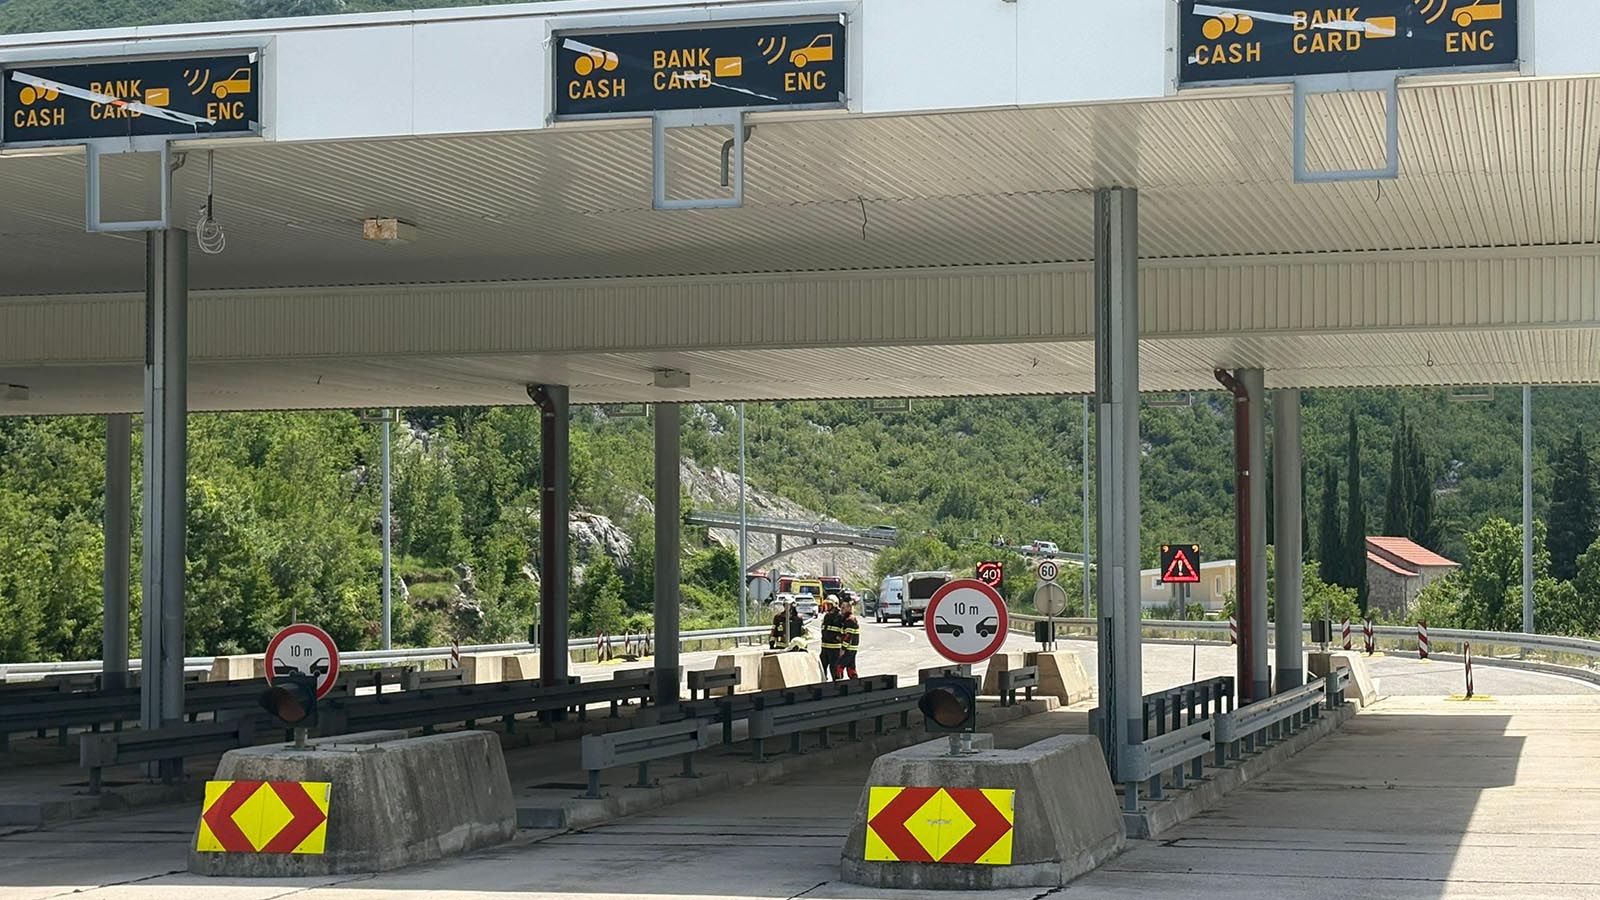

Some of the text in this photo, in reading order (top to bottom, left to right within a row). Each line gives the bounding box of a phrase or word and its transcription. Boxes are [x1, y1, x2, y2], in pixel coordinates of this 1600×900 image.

[1293, 7, 1360, 31] BANK
[1293, 31, 1361, 54] CARD
[1446, 30, 1494, 53] ENC
[653, 48, 711, 69] BANK
[1196, 41, 1261, 65] CASH
[90, 80, 141, 98] BANK
[568, 79, 625, 100] CASH
[653, 69, 711, 90] CARD
[784, 70, 826, 92] ENC
[14, 108, 65, 128] CASH
[207, 102, 244, 120] ENC
[982, 569, 997, 580] 40
[1041, 565, 1054, 577] 60
[954, 602, 979, 615] 10 m
[290, 645, 312, 657] 10 m
